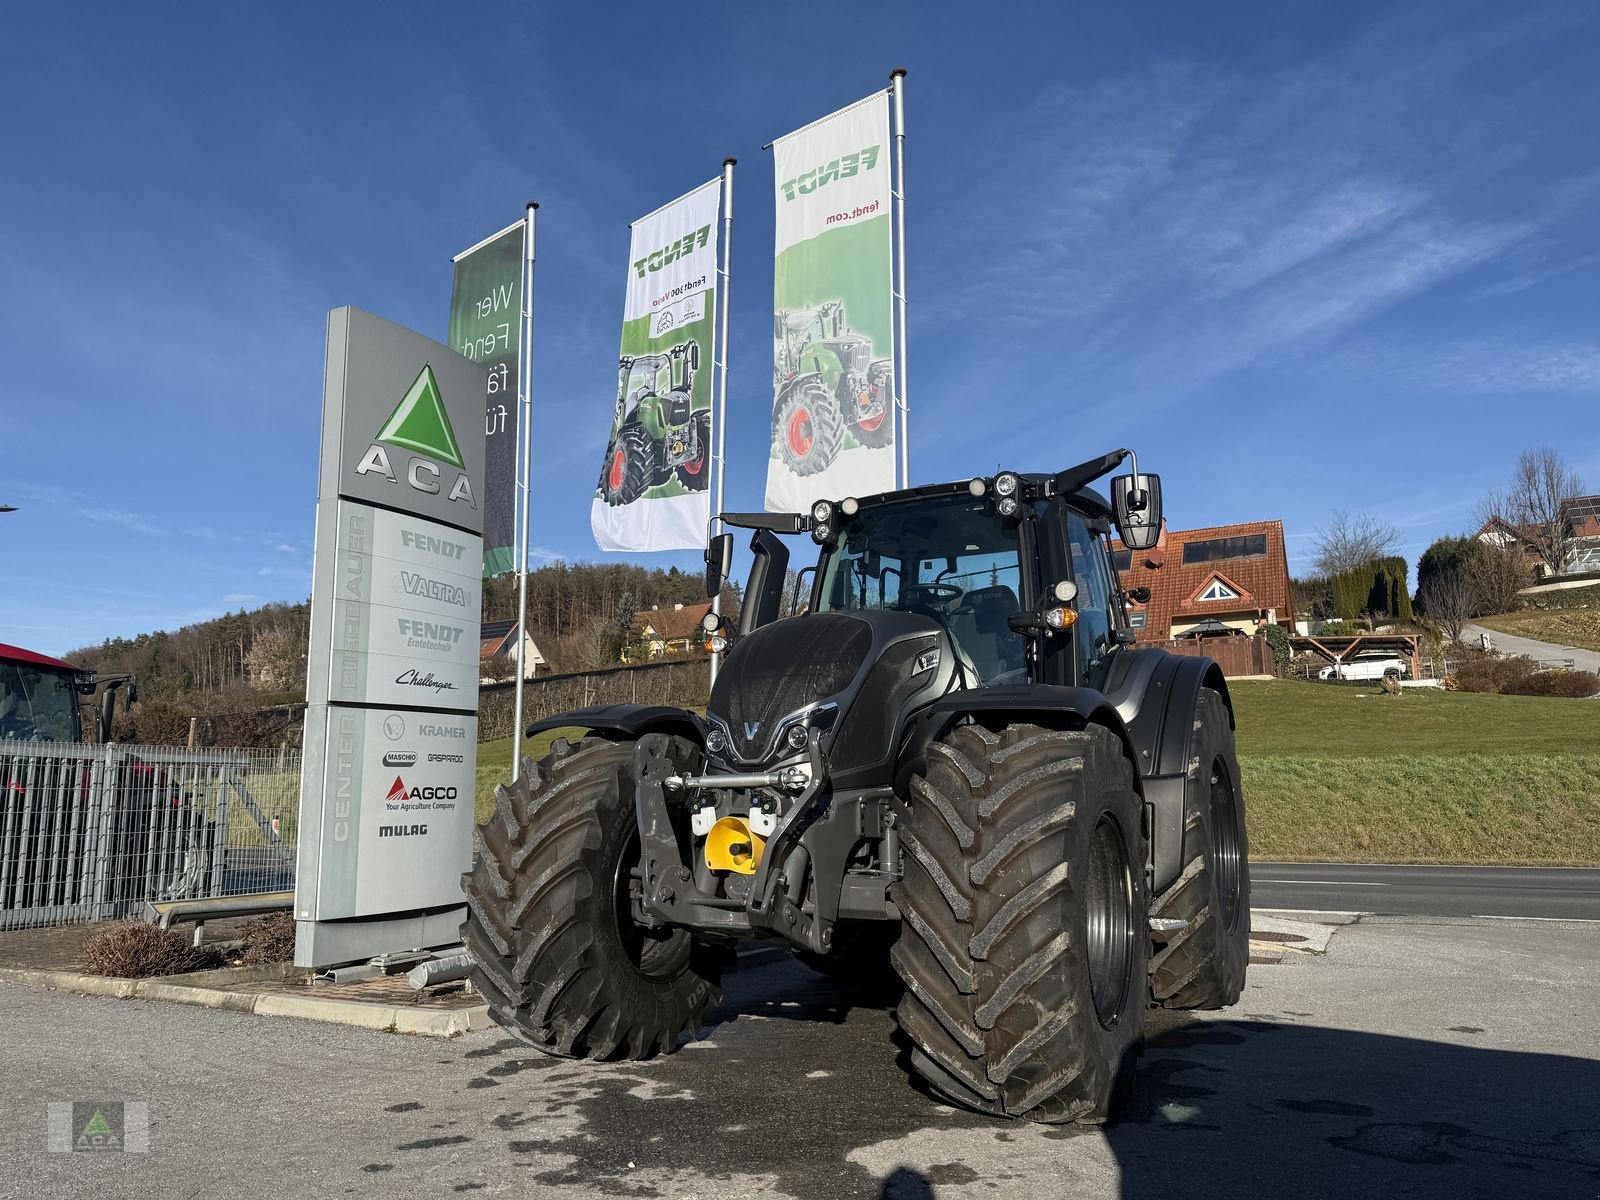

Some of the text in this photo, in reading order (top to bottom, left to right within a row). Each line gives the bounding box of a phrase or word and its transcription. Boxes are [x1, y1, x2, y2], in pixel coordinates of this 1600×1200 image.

[354, 443, 478, 510] ACA
[400, 530, 466, 560] FENDT
[400, 571, 466, 607] VALTRA
[397, 618, 464, 643] FENDT
[407, 637, 452, 652] Erntetechnik
[334, 514, 365, 842] CENTER BIERBAUER
[395, 669, 460, 694] Challenger
[419, 724, 466, 739] KRAMER
[387, 753, 416, 761] MASCHIO
[427, 753, 463, 763] GASPARDO
[409, 787, 457, 800] AGCO
[386, 802, 455, 812] Your Agriculture Company
[379, 824, 428, 837] MULAG
